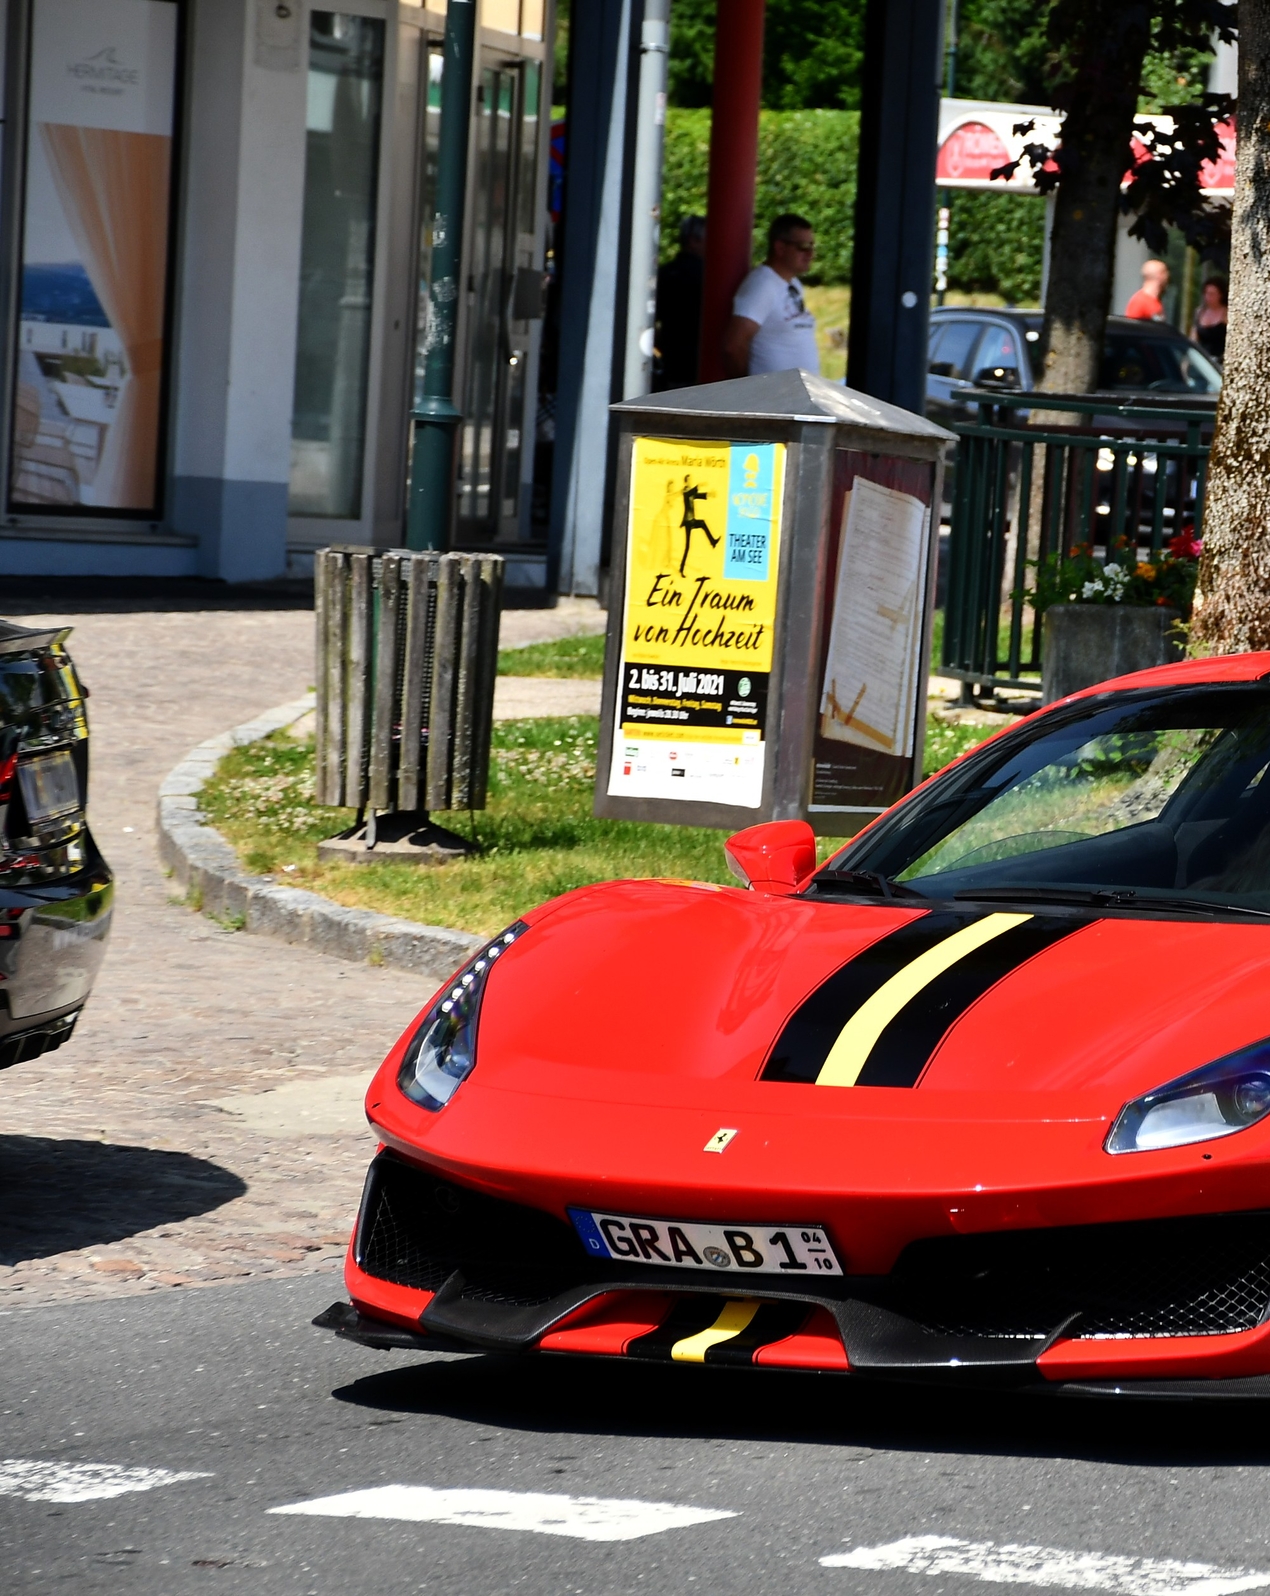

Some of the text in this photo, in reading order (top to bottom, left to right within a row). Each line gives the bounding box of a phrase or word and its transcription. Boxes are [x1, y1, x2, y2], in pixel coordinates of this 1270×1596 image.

[681, 455, 702, 466] Maria
[704, 456, 726, 468] Wörth
[729, 533, 767, 549] THEATER
[730, 549, 763, 564] AM SEE
[646, 573, 755, 615] Ein Traum
[633, 613, 765, 650] von Hochzeit
[628, 668, 725, 697] 2. bis 31. Juli 2021
[588, 1237, 600, 1249] D
[599, 1218, 808, 1270] GRA B 1
[801, 1231, 822, 1244] 04
[814, 1257, 833, 1271] 10
